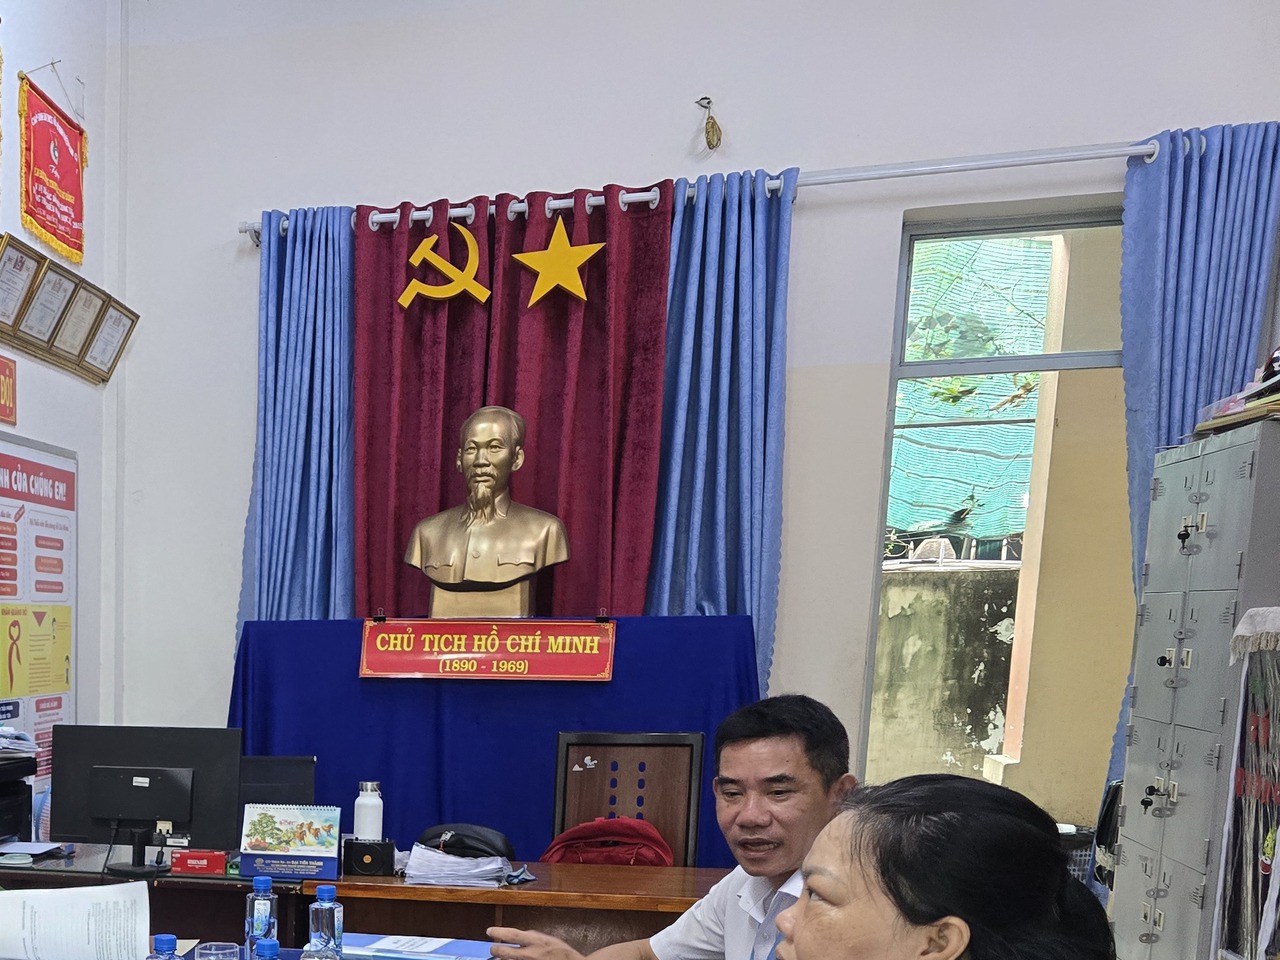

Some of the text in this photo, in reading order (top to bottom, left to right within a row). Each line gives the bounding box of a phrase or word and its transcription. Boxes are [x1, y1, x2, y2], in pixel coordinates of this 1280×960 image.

[0, 368, 13, 414] ĐỘI
[11, 464, 28, 494] CỦA
[29, 469, 53, 499] CHÚNG
[54, 484, 67, 502] EM!
[376, 625, 600, 656] CHỦ TỊCH HỒ CHÍ MINH
[439, 659, 477, 673] (1890
[491, 660, 529, 675] 1969)
